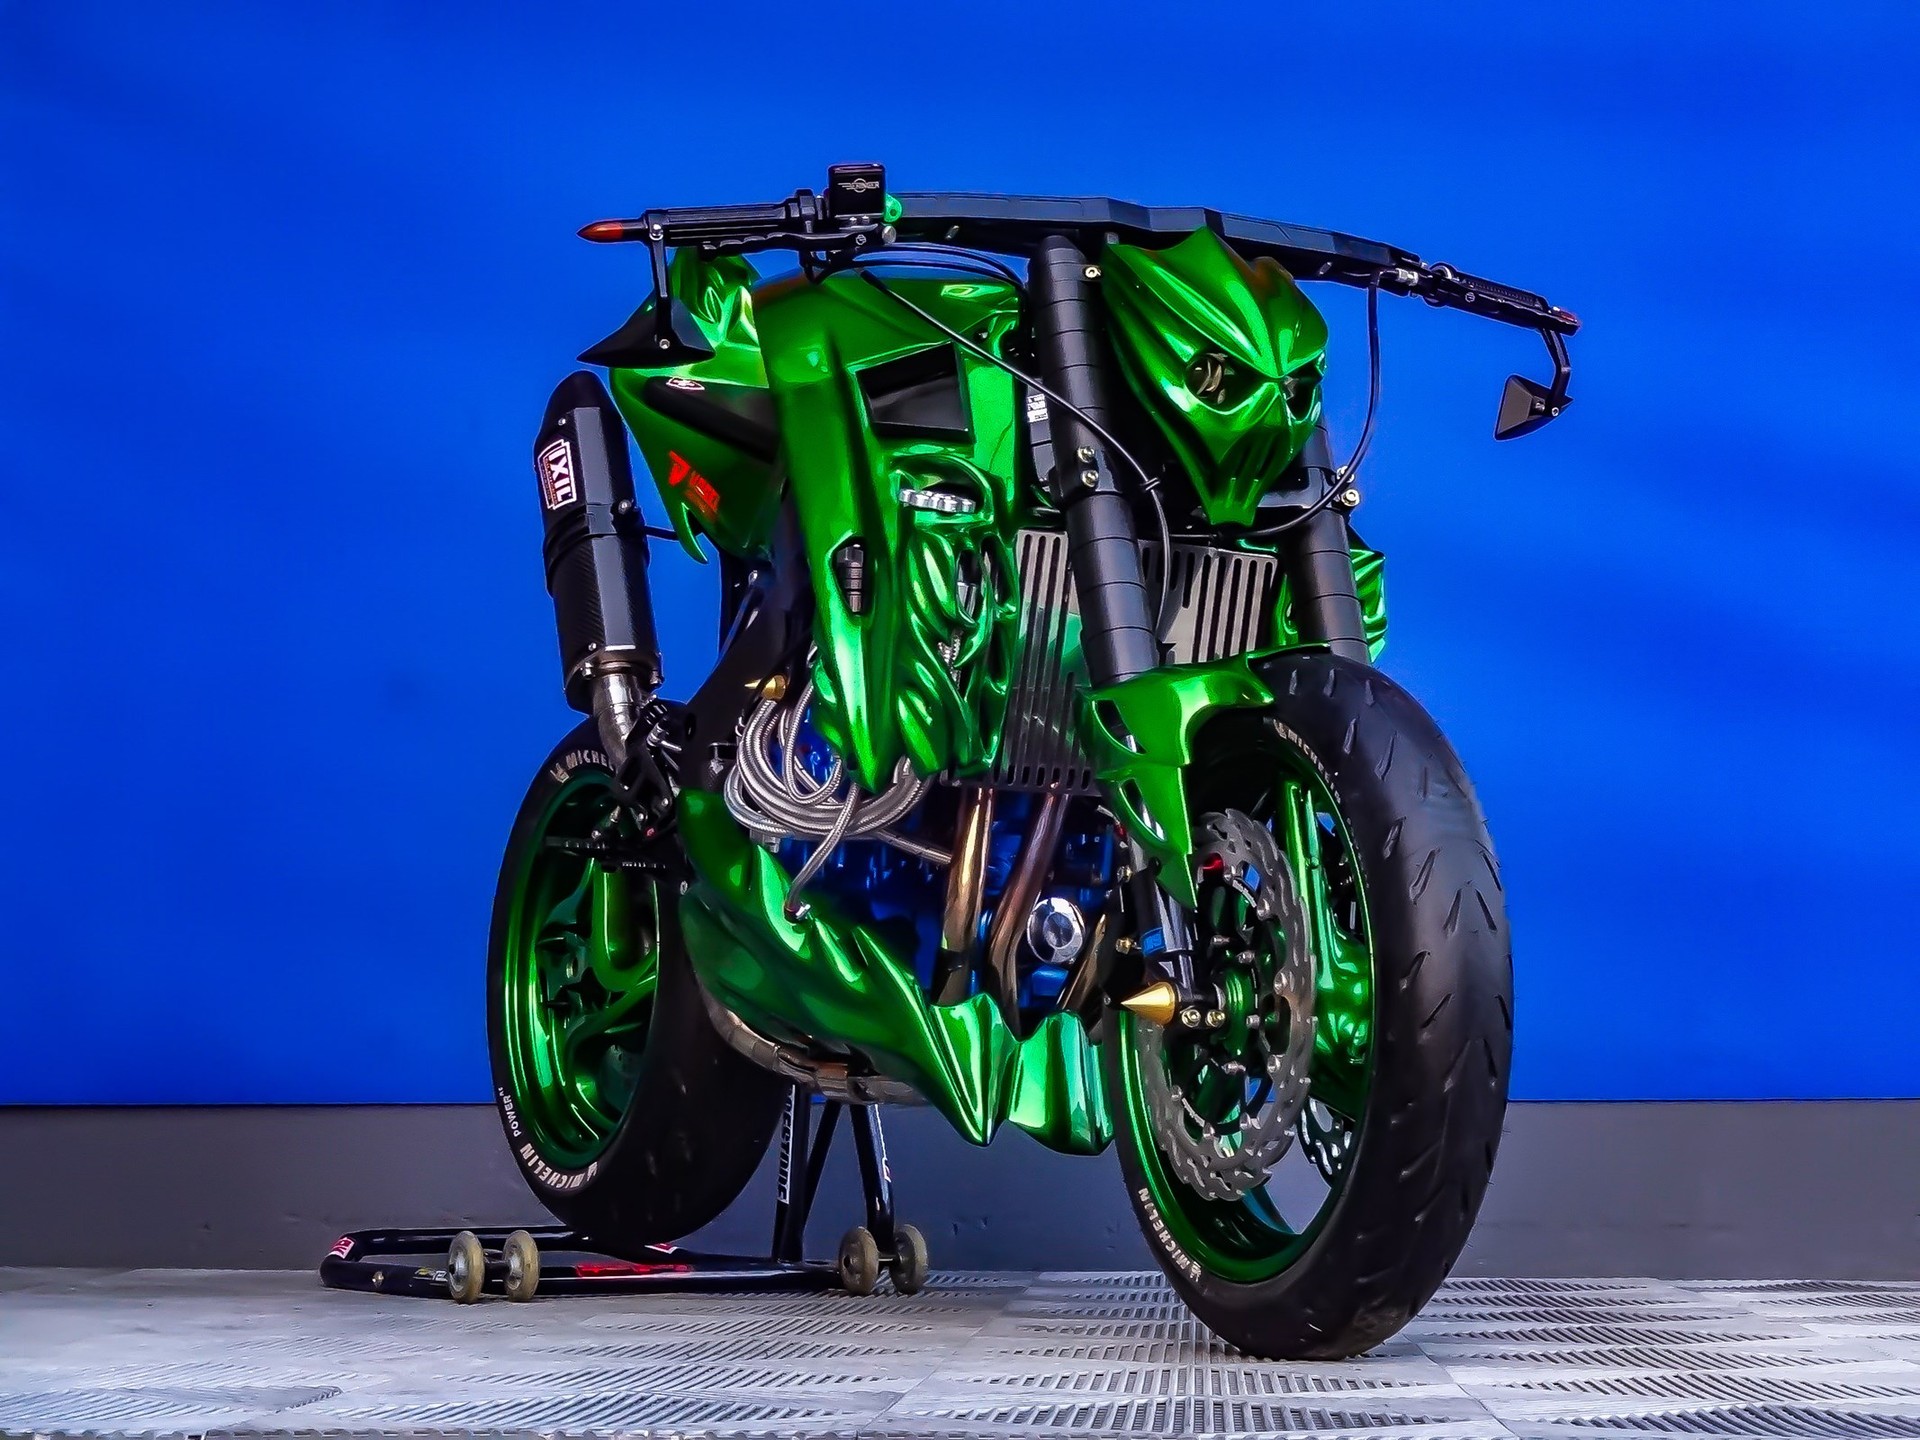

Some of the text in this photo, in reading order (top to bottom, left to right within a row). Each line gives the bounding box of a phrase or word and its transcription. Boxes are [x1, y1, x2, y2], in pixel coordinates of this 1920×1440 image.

[548, 447, 572, 502] IXIL
[502, 1094, 522, 1138] POWER
[519, 1143, 586, 1189] MICHELIN
[1138, 1187, 1191, 1270] MICHELIN
